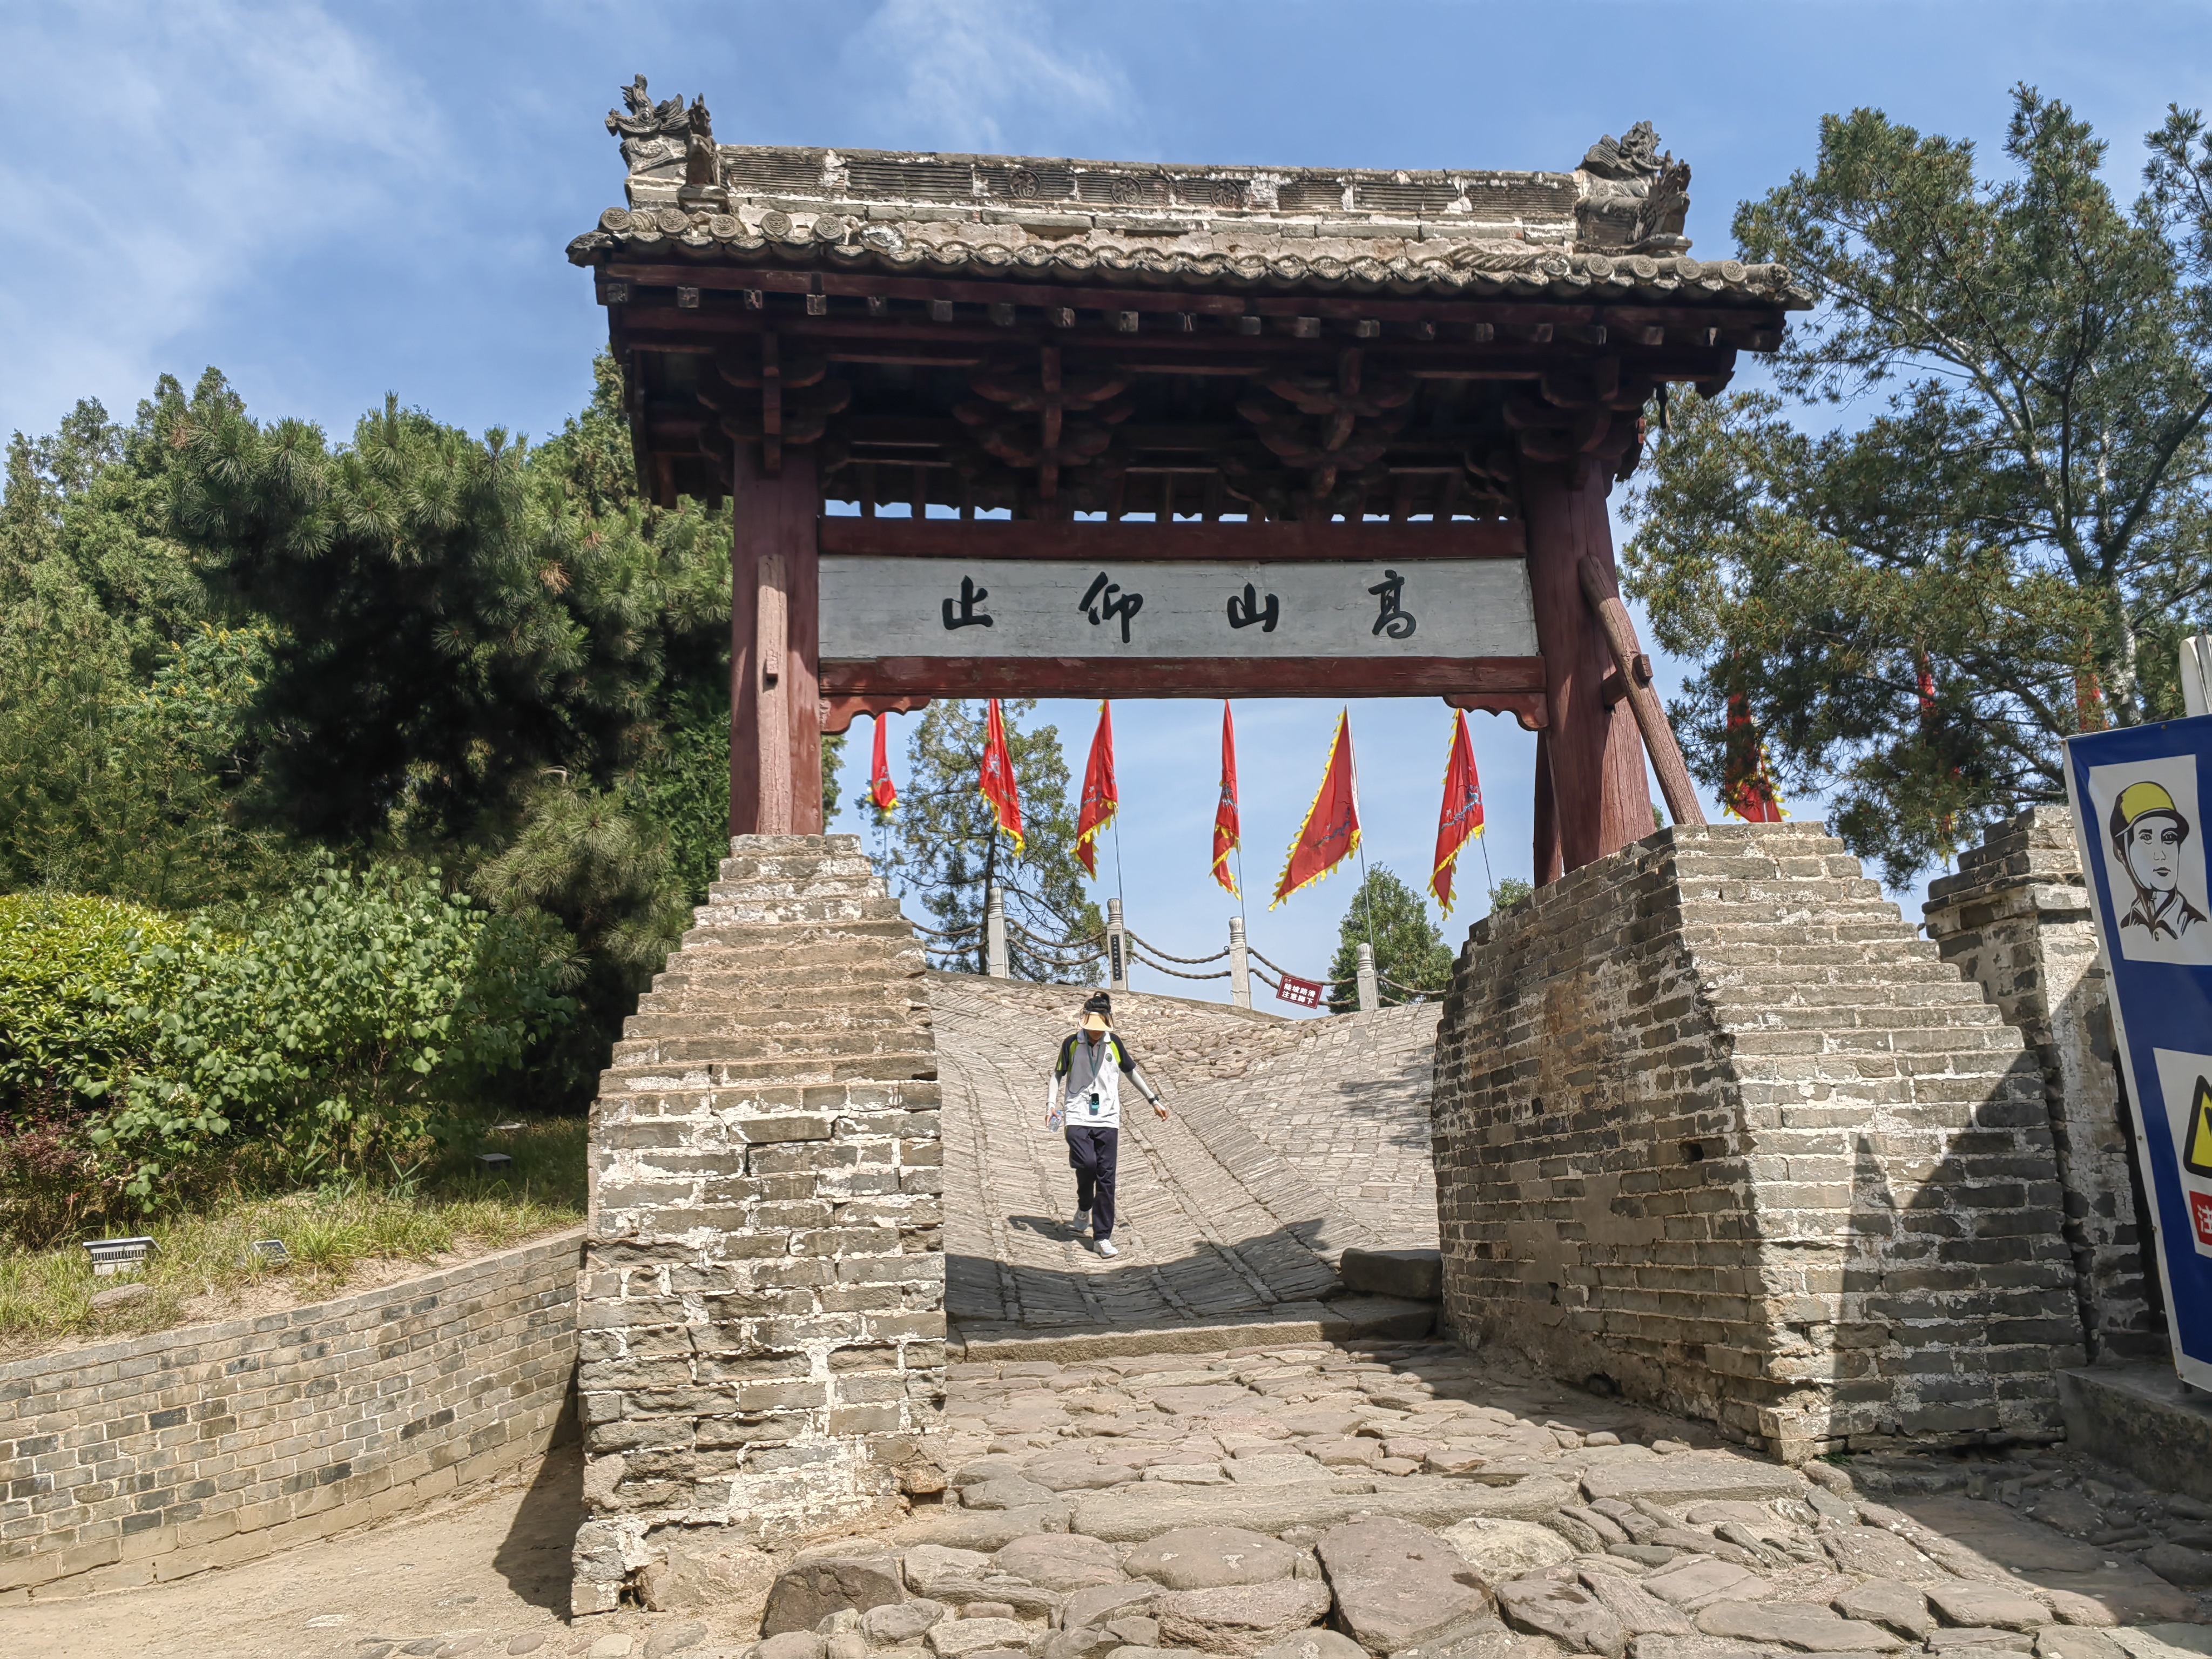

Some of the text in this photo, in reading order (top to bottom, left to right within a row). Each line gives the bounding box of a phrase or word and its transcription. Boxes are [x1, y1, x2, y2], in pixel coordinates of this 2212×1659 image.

[942, 569, 1417, 644] 高山仰止
[1282, 990, 1314, 1004] 注意脚下
[1284, 983, 1316, 998] 陡坡路滑
